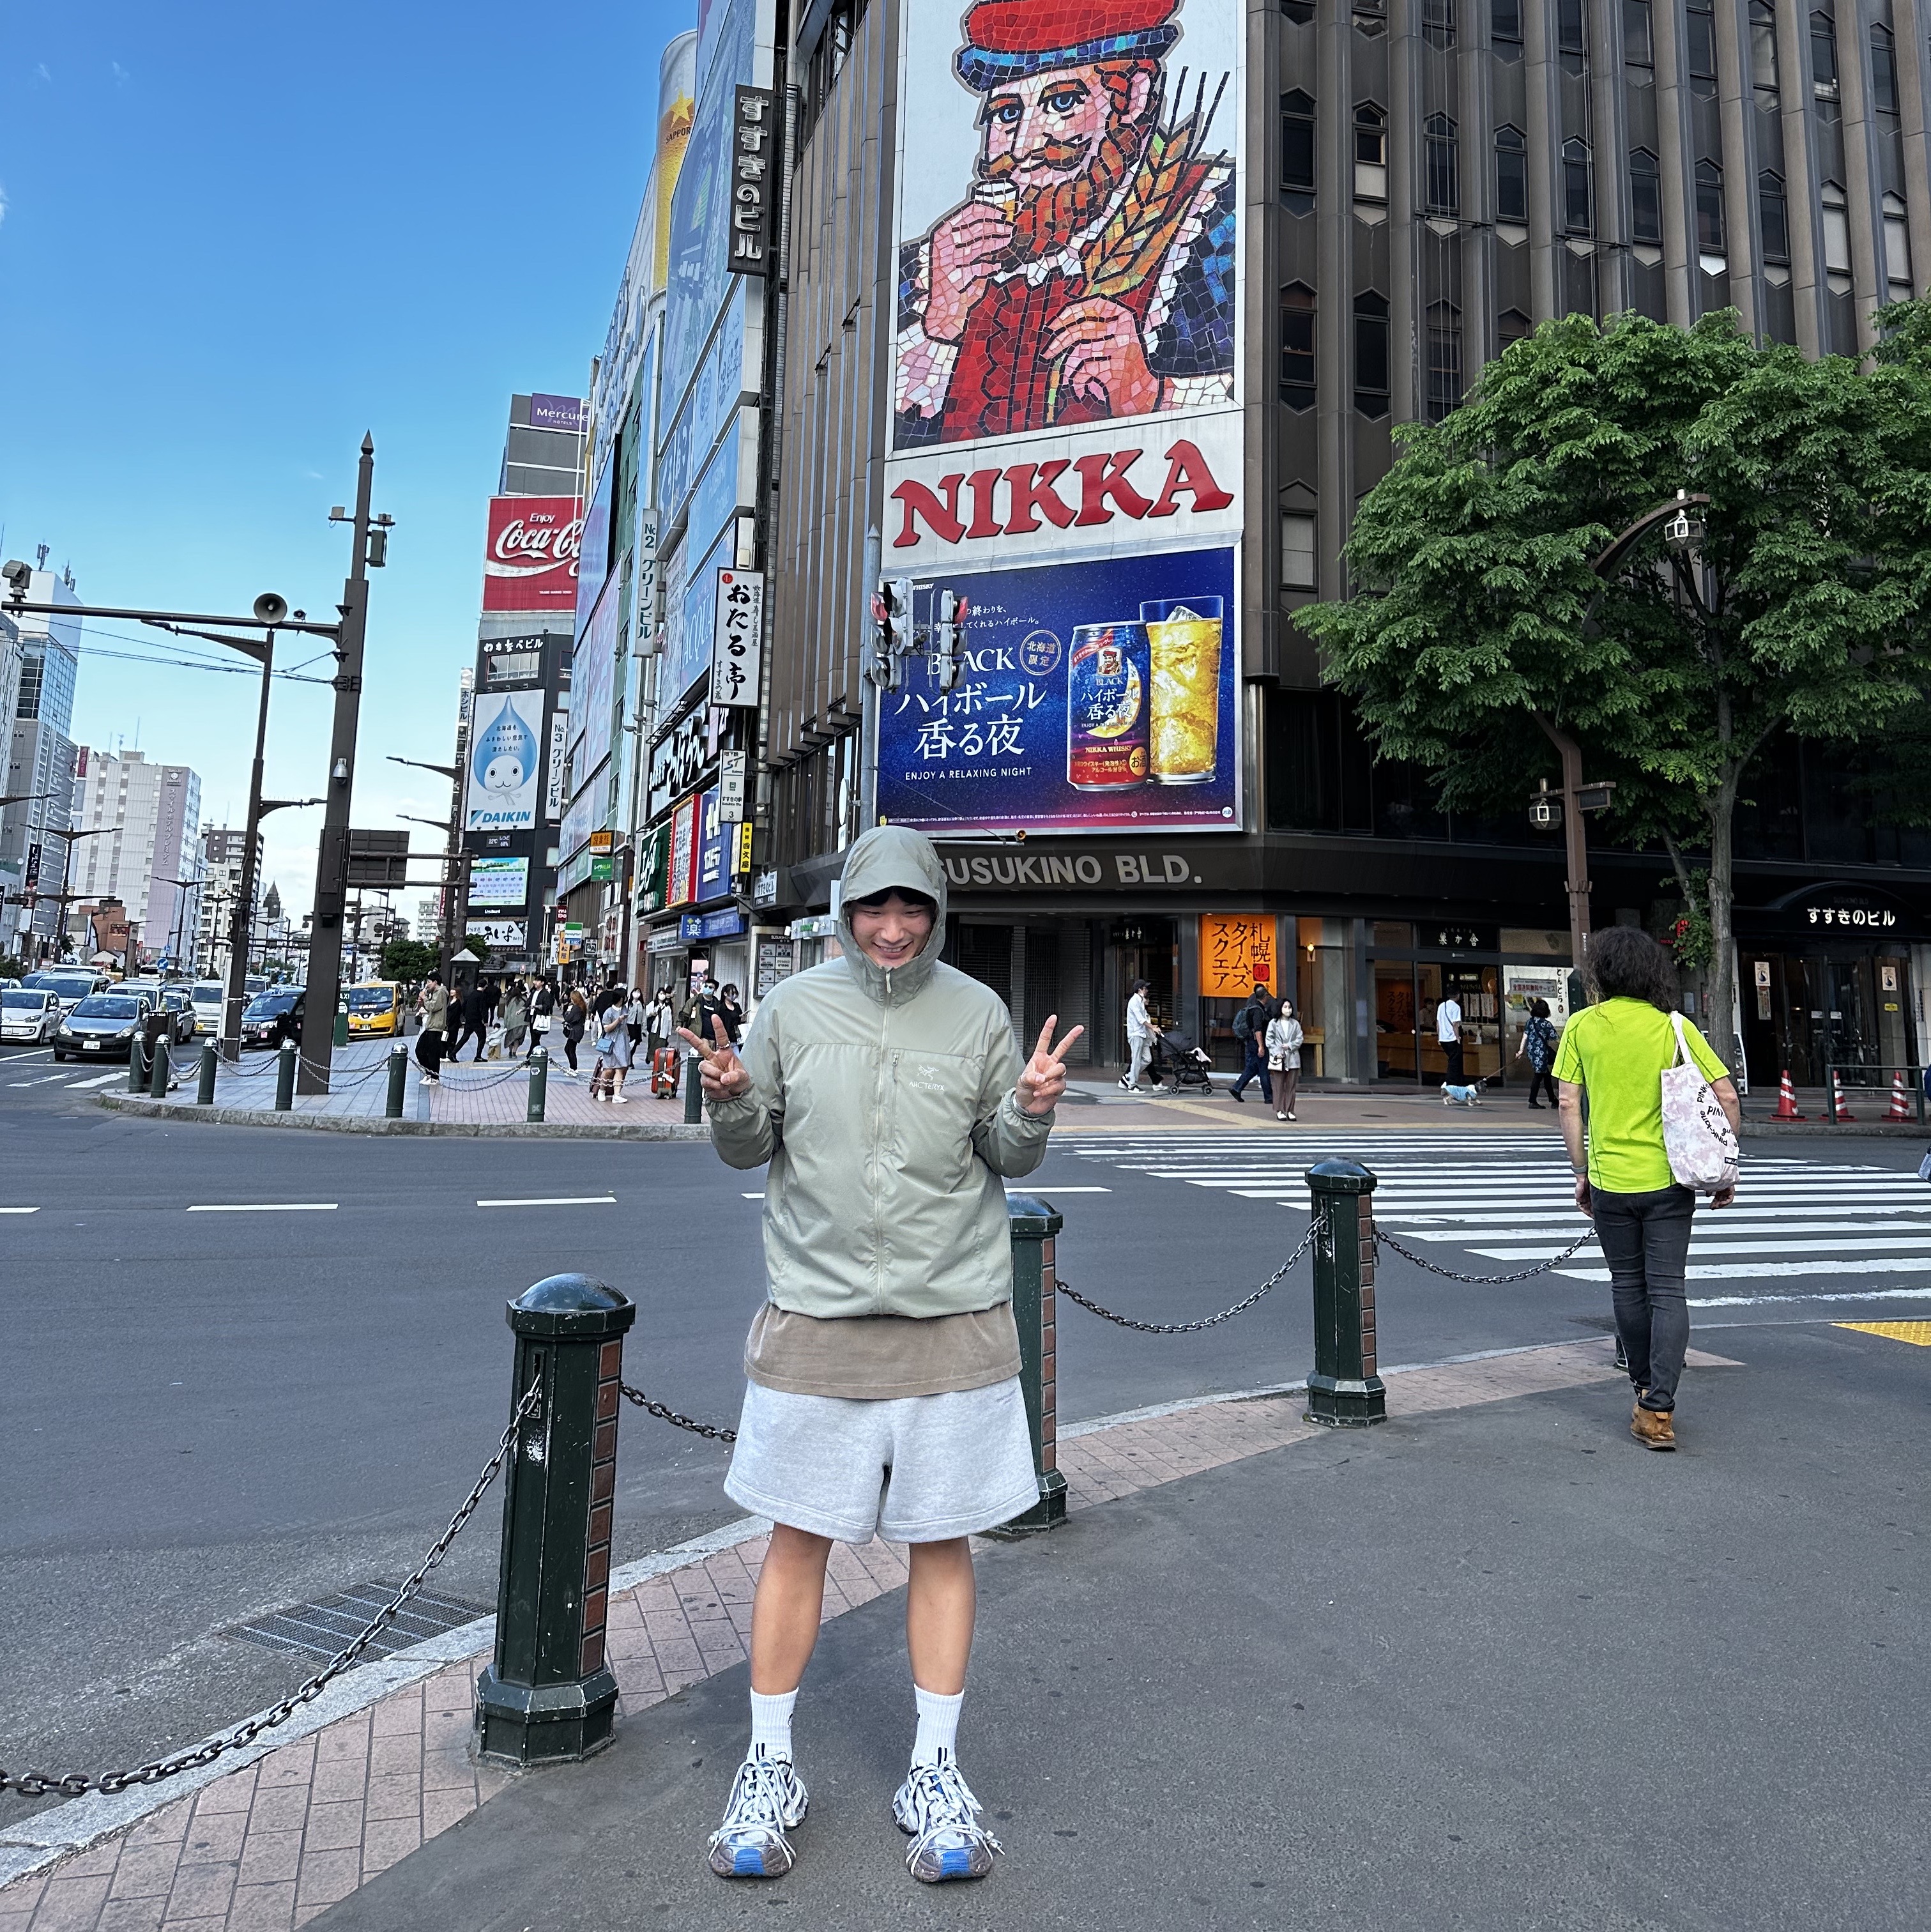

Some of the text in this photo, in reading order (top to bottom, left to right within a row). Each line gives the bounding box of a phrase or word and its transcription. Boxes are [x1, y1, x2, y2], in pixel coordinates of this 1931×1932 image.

[666, 126, 691, 144] SAPPOR
[734, 95, 769, 259] すすきのビル
[537, 408, 588, 422] Mercure
[891, 439, 1235, 548] NIKKA
[530, 513, 556, 524] Enjoy
[637, 559, 657, 640] グリーンビル
[934, 617, 1039, 633] 幸してくれるハイボール。
[726, 584, 751, 700] おたる亭
[1027, 641, 1057, 654] 北海道
[926, 647, 1016, 675] BACK
[1028, 654, 1051, 666] 限定
[1095, 678, 1124, 686] BLACK
[894, 681, 1047, 716] ハイボール
[1081, 688, 1138, 702] ハイボール
[1087, 702, 1133, 721] 香る夜
[913, 714, 1025, 760] 香る夜
[549, 749, 563, 808] グリーンビル
[904, 767, 1033, 781] ENJOY A RELAXING NIGHT
[482, 811, 531, 824] DAIKIN
[1115, 855, 1202, 884] BLD.
[1807, 907, 1896, 926] すすきのビル
[1249, 922, 1271, 963] 札幌
[1211, 922, 1230, 990] スクエア
[1230, 921, 1252, 988] タイムズ
